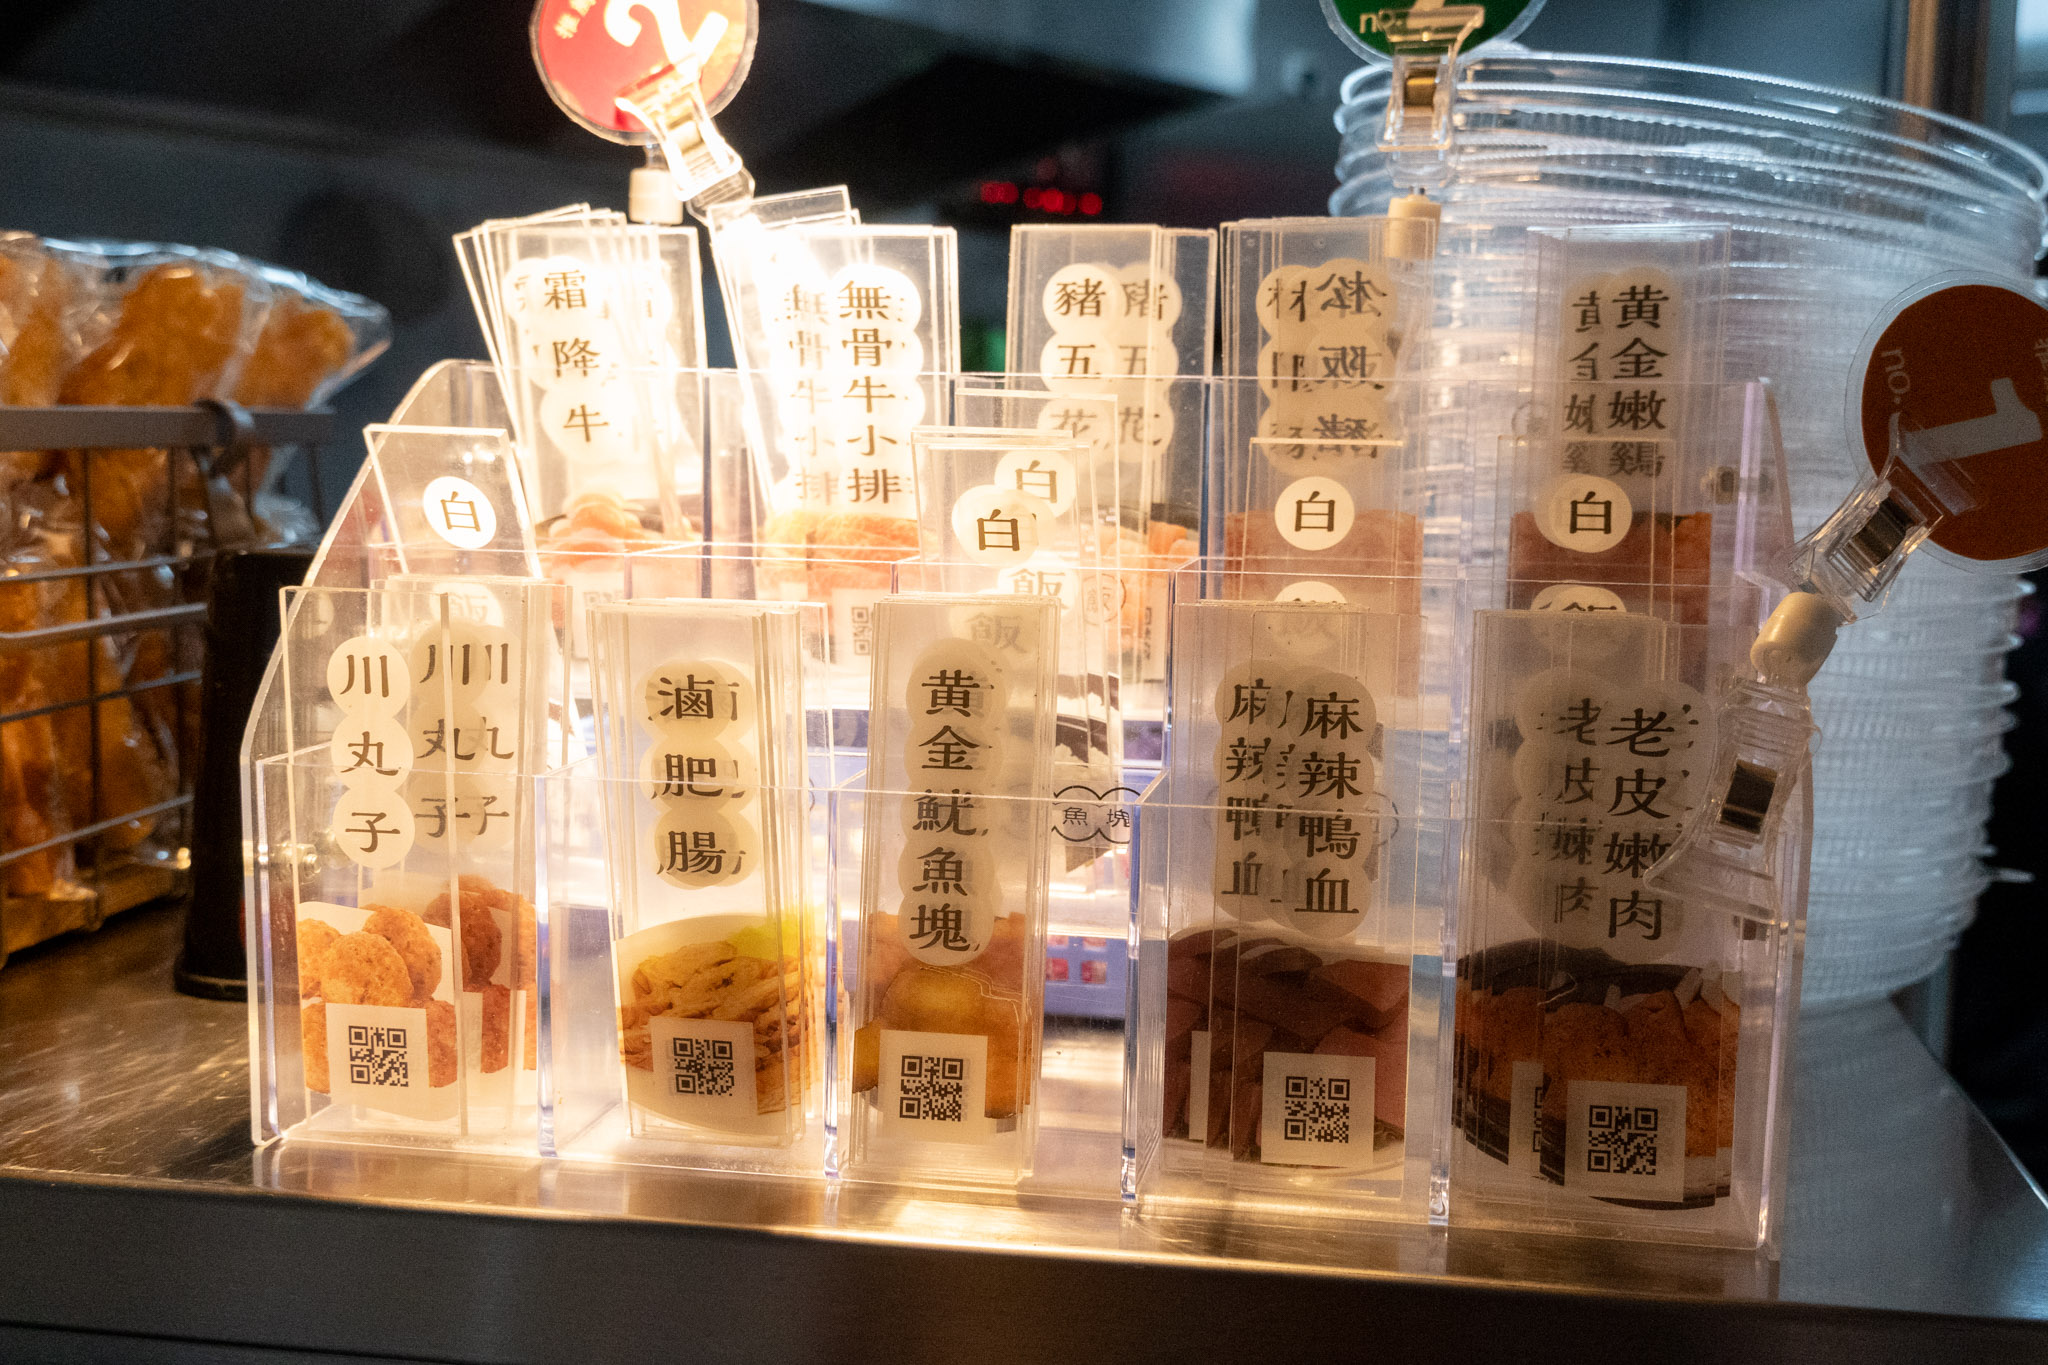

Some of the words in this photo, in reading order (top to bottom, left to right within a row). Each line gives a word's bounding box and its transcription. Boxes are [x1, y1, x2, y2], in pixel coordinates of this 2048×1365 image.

[544, 268, 611, 443] 霜降牛
[837, 279, 903, 505] 無骨牛小排
[1889, 376, 2042, 470] 1
[340, 654, 402, 853] 川丸子
[657, 674, 727, 875] 滷肥腸
[1294, 691, 1364, 914] 麻辣鴨血
[1601, 707, 1675, 940] 老皮嫩肉
